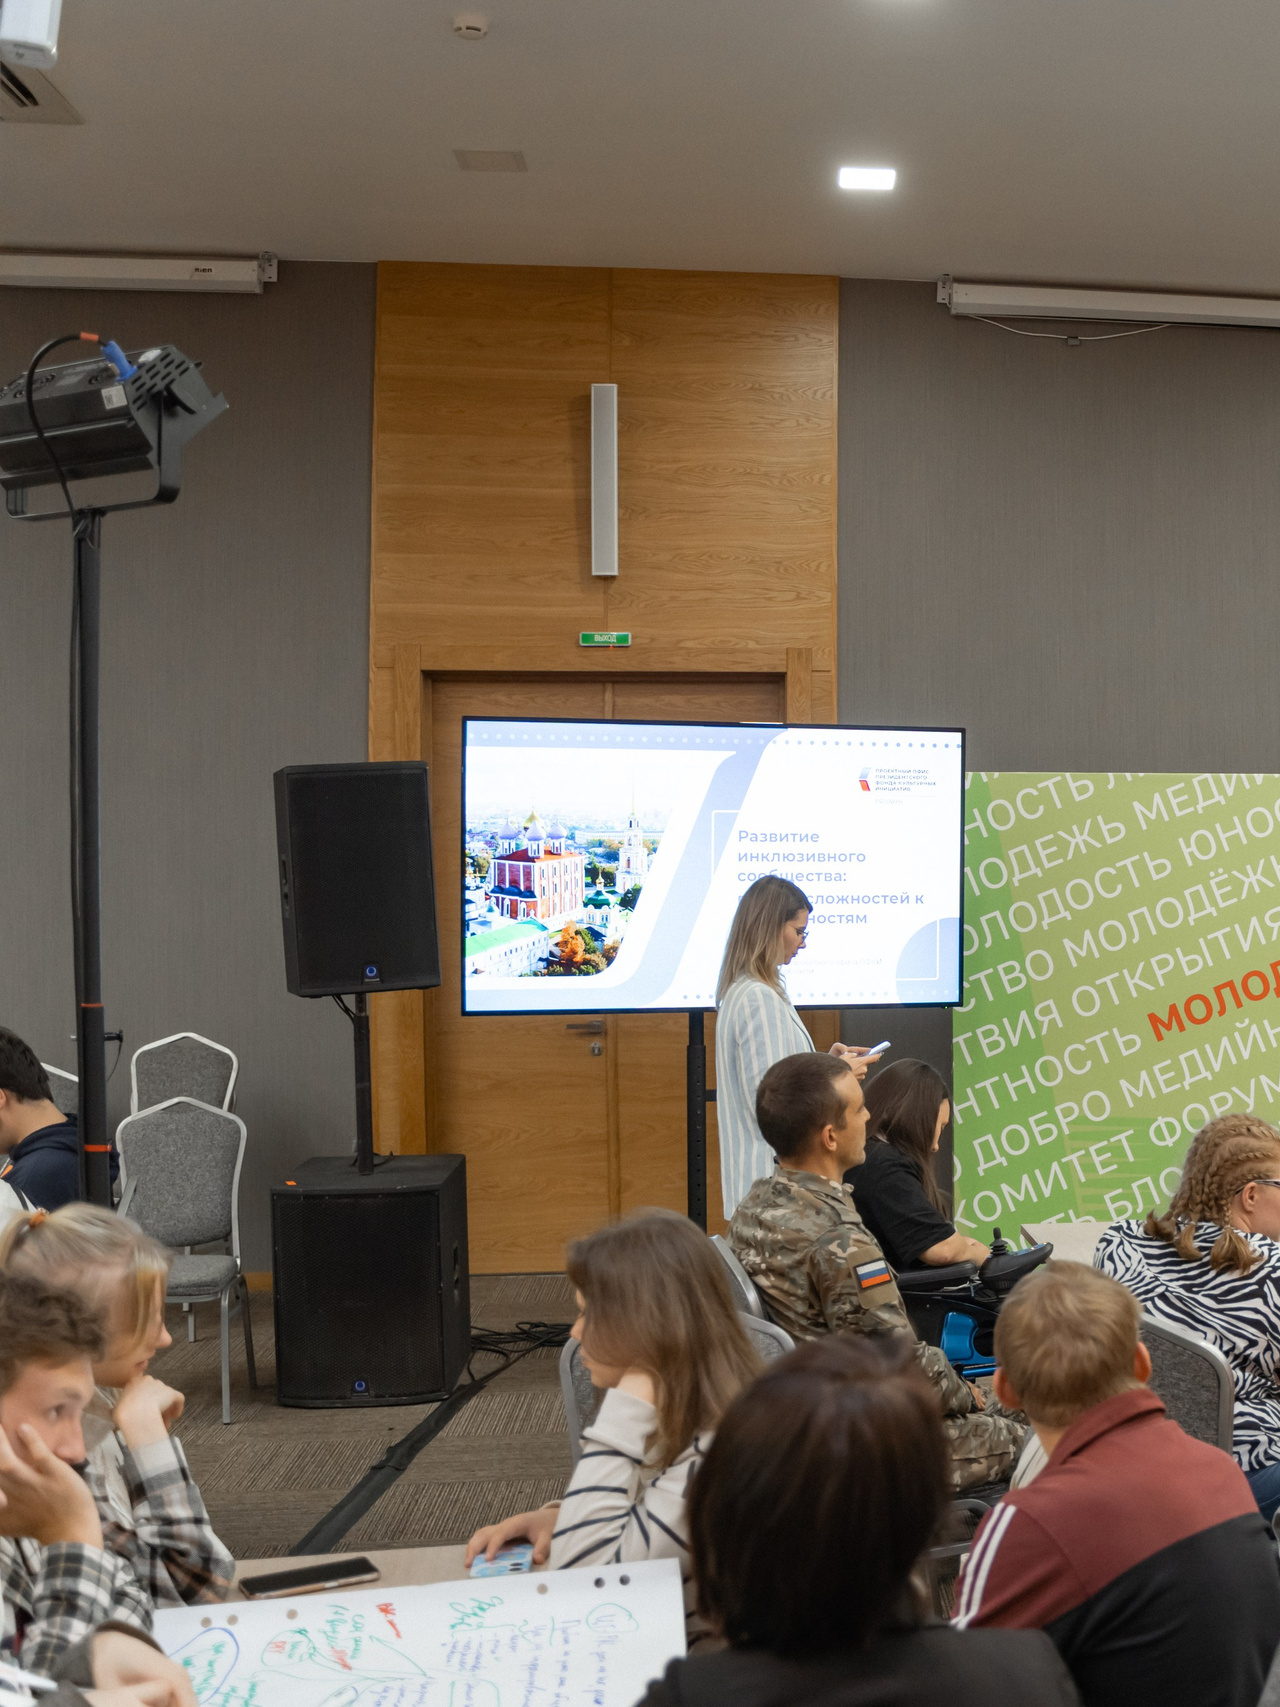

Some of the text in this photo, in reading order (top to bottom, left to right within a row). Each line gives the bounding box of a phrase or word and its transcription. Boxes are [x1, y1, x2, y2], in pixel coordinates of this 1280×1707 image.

[594, 635, 617, 643] ВЫХОД
[738, 830, 820, 843] Развитие
[738, 852, 866, 862] инклюзивного
[737, 869, 847, 883] сообщества:
[915, 895, 925, 905] к
[953, 999, 1063, 1065] ТВИЯ
[973, 1090, 1111, 1177] ДОБРО
